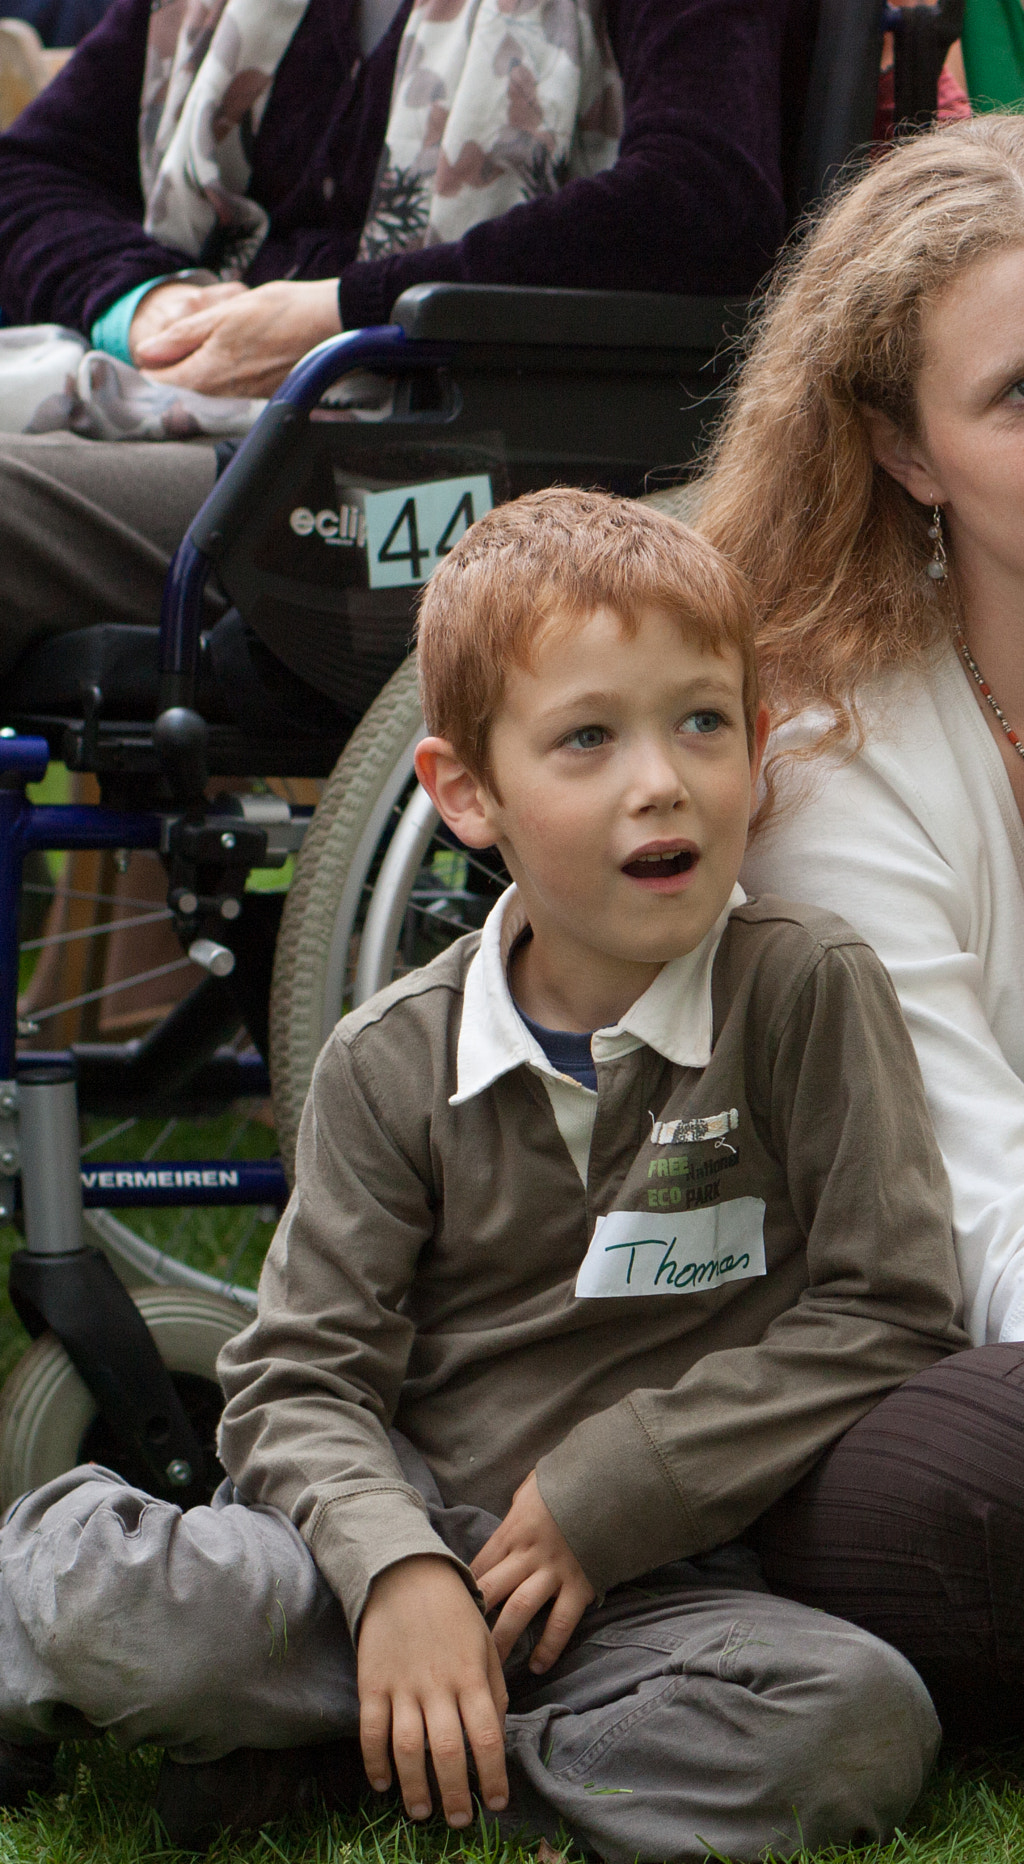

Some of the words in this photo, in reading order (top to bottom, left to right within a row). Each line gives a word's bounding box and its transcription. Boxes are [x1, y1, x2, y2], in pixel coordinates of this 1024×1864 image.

[80, 1170, 238, 1188] VERMEIREN
[647, 1156, 690, 1179] FREE
[647, 1186, 682, 1207] ECO
[685, 1179, 720, 1210] PARK
[604, 1236, 751, 1288] Thomas
